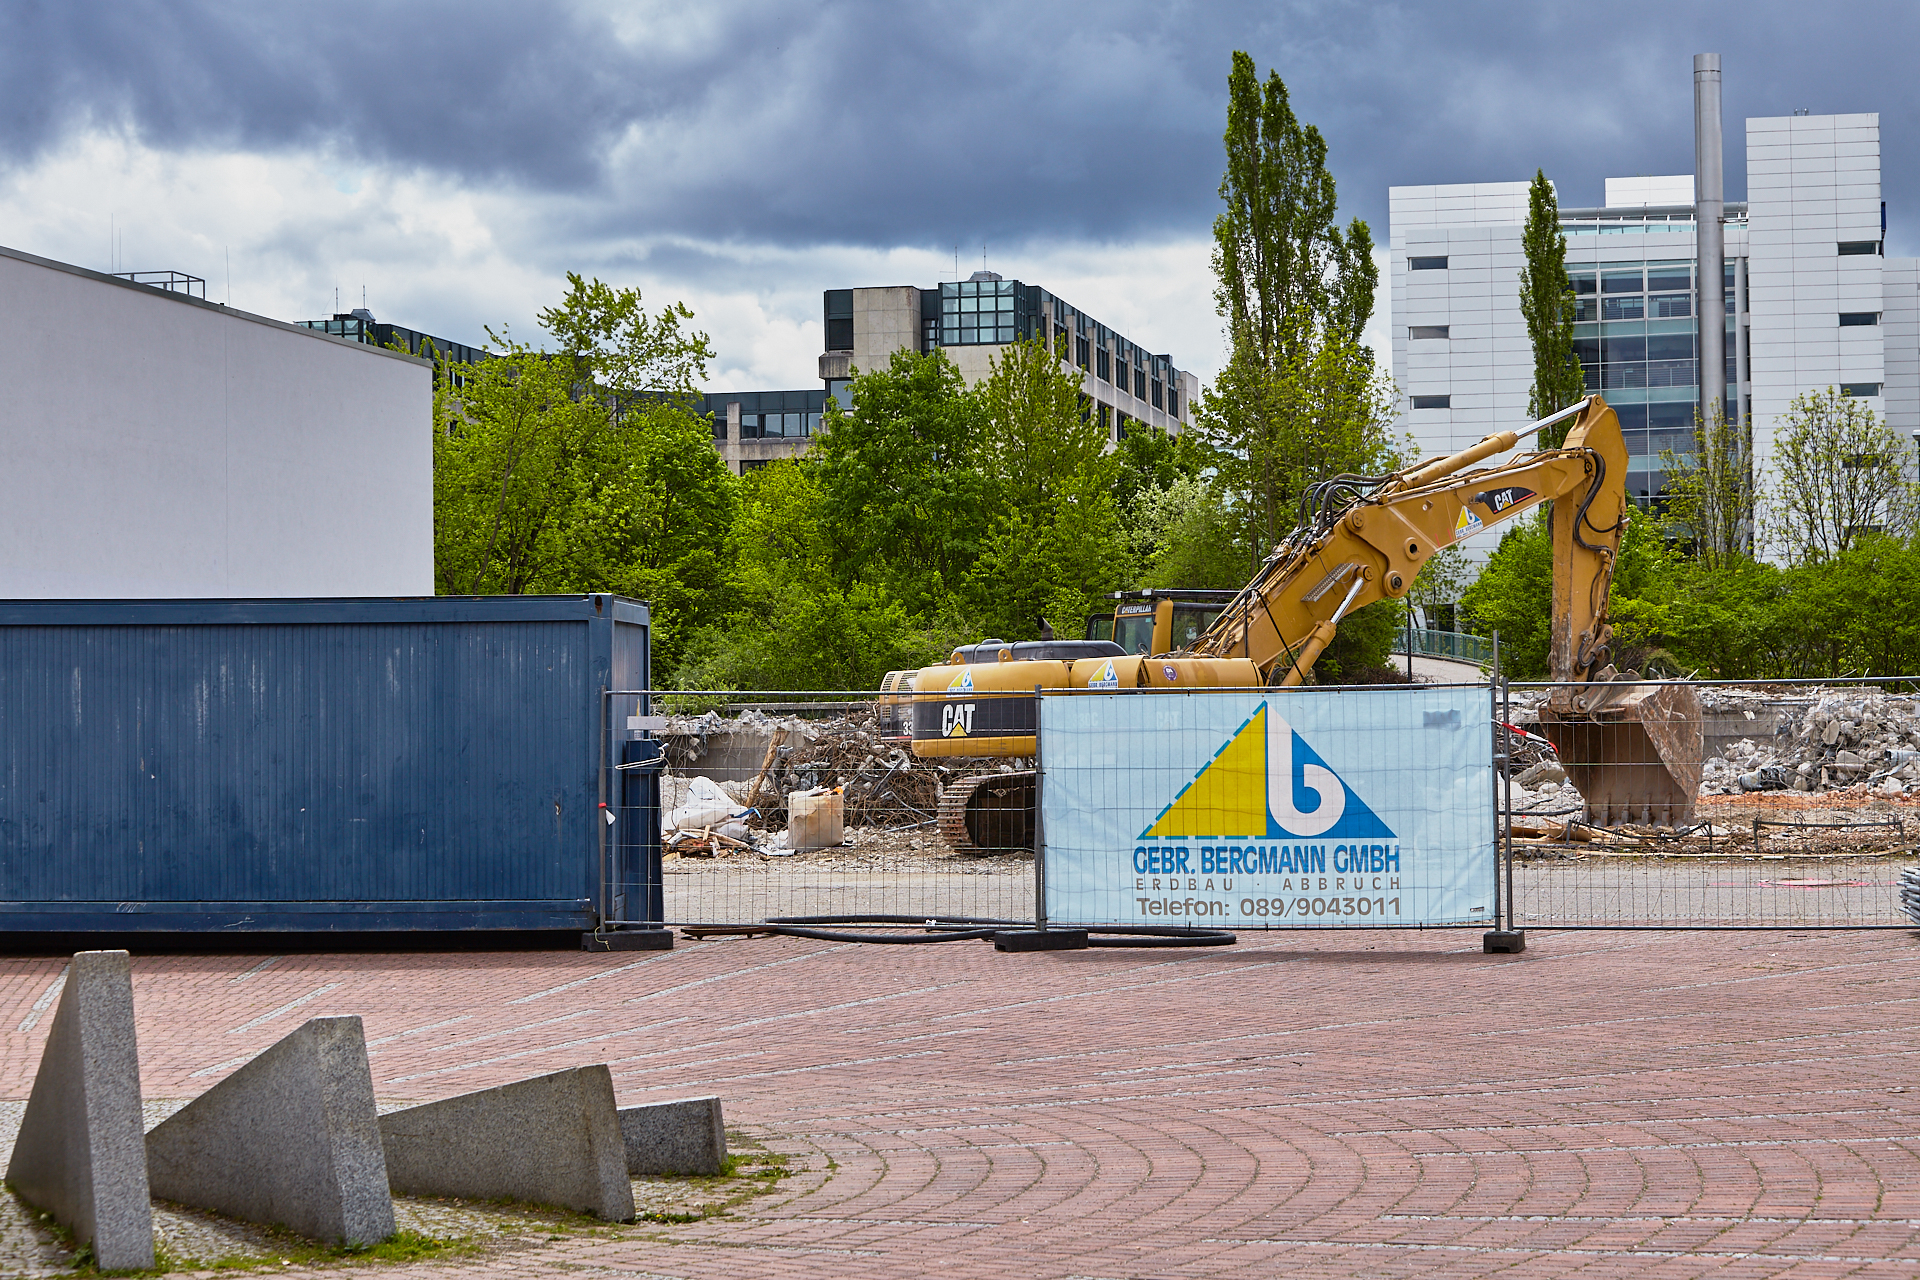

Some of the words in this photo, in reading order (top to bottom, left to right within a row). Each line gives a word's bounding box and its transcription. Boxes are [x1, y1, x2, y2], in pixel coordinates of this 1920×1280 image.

[1494, 488, 1514, 511] CAT
[942, 703, 976, 738] CAT
[1133, 845, 1196, 875] GEBR.
[1201, 845, 1326, 875] BERGMANN
[1333, 844, 1400, 874] GMBH
[1136, 877, 1233, 891] ERDBAU
[1282, 876, 1400, 891] ABBRUCH
[1136, 897, 1230, 916] Telefon:
[1240, 896, 1400, 918] 089/9043011
